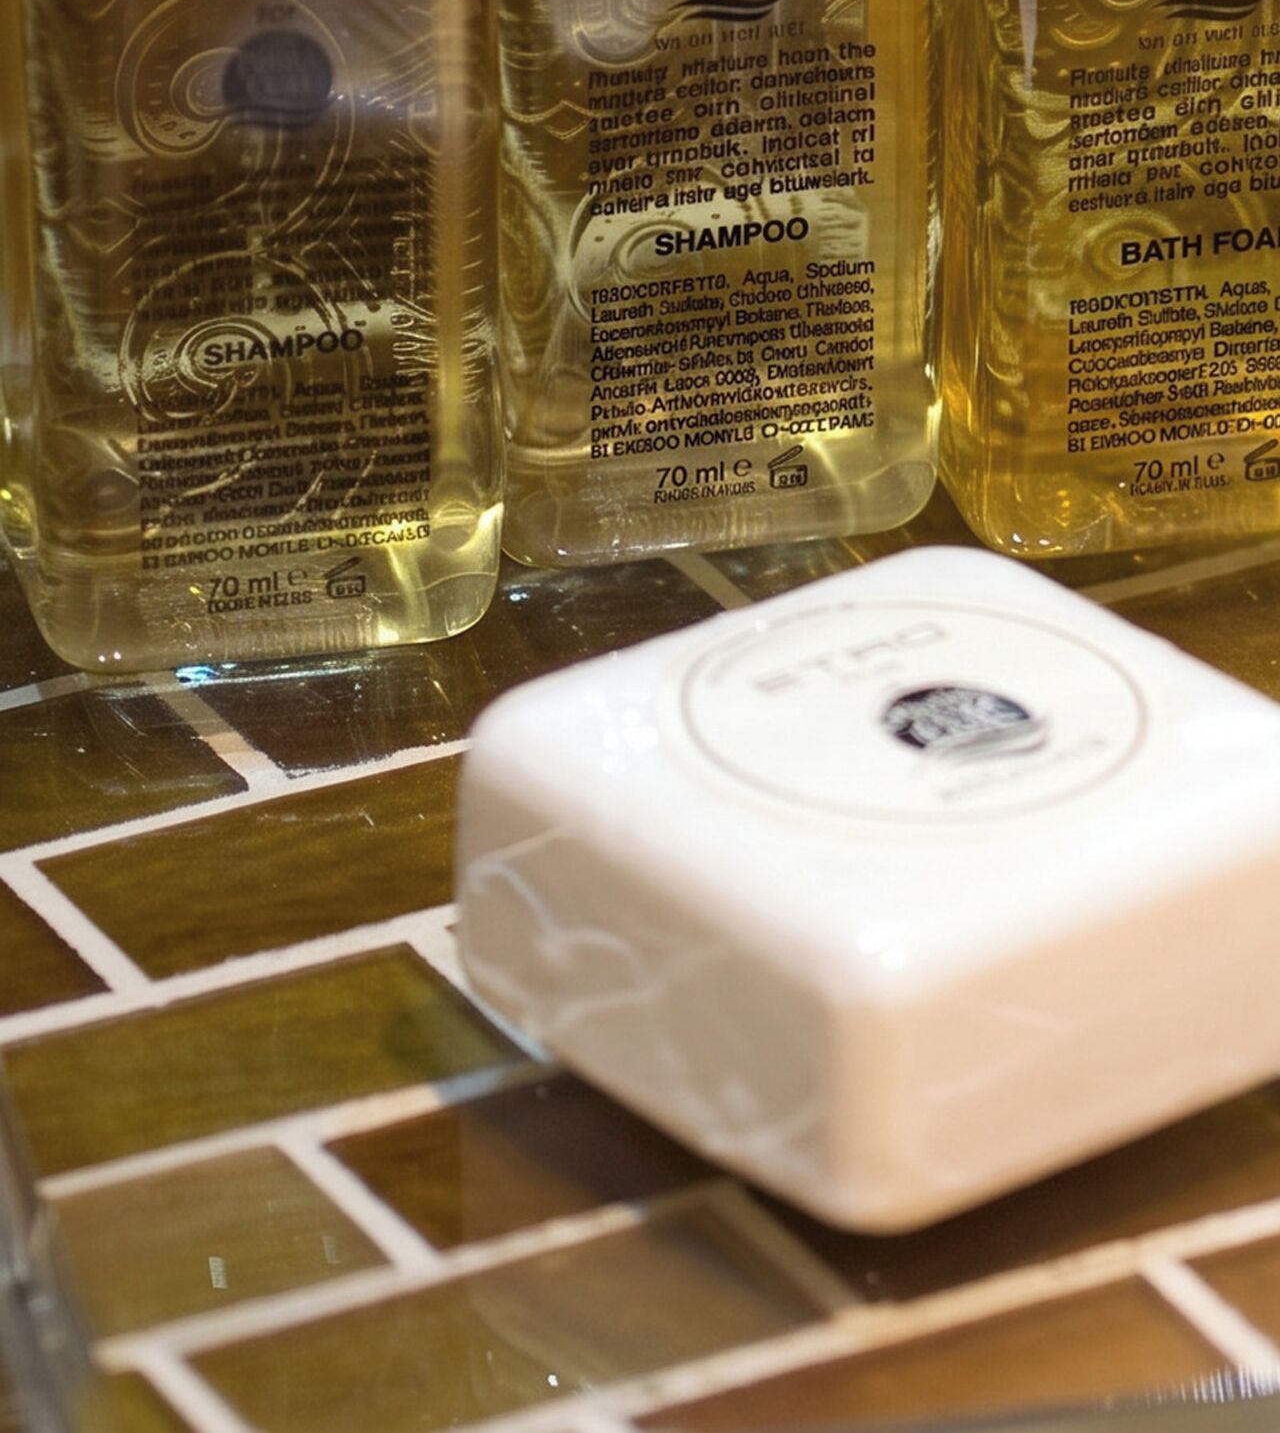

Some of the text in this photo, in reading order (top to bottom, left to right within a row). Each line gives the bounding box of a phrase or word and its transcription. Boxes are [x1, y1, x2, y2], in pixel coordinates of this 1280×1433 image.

[655, 217, 809, 255] SHAMPOO
[1120, 235, 1202, 266] BATH
[204, 328, 363, 366] SHAMPOO
[656, 466, 687, 488] 70
[696, 461, 725, 484] ml
[1133, 461, 1162, 482] 70
[1171, 455, 1199, 477] ml
[208, 577, 240, 601] 70
[249, 571, 279, 592] ml
